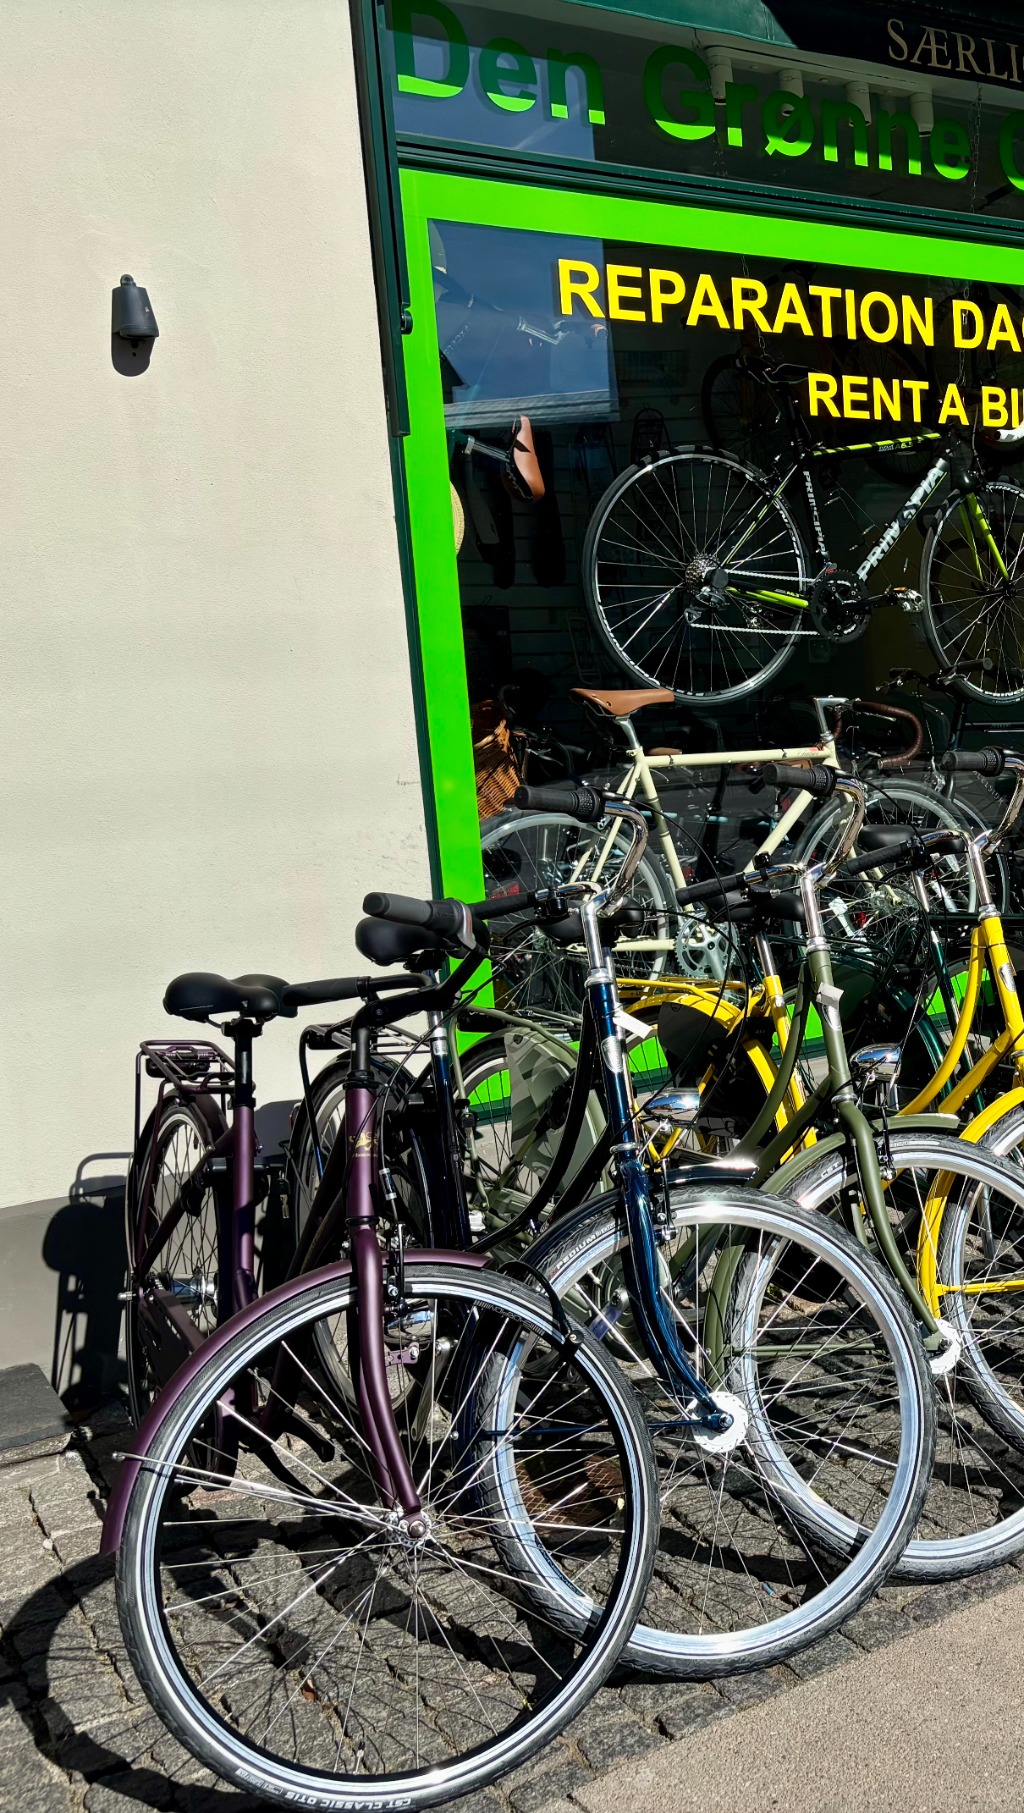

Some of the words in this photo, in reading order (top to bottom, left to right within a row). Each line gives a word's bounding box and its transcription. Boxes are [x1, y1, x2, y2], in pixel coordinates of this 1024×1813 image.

[394, 0, 607, 126] Den
[643, 44, 971, 182] Grønne
[558, 259, 934, 348] REPARATION
[808, 372, 930, 423] RENT
[939, 383, 969, 426] A
